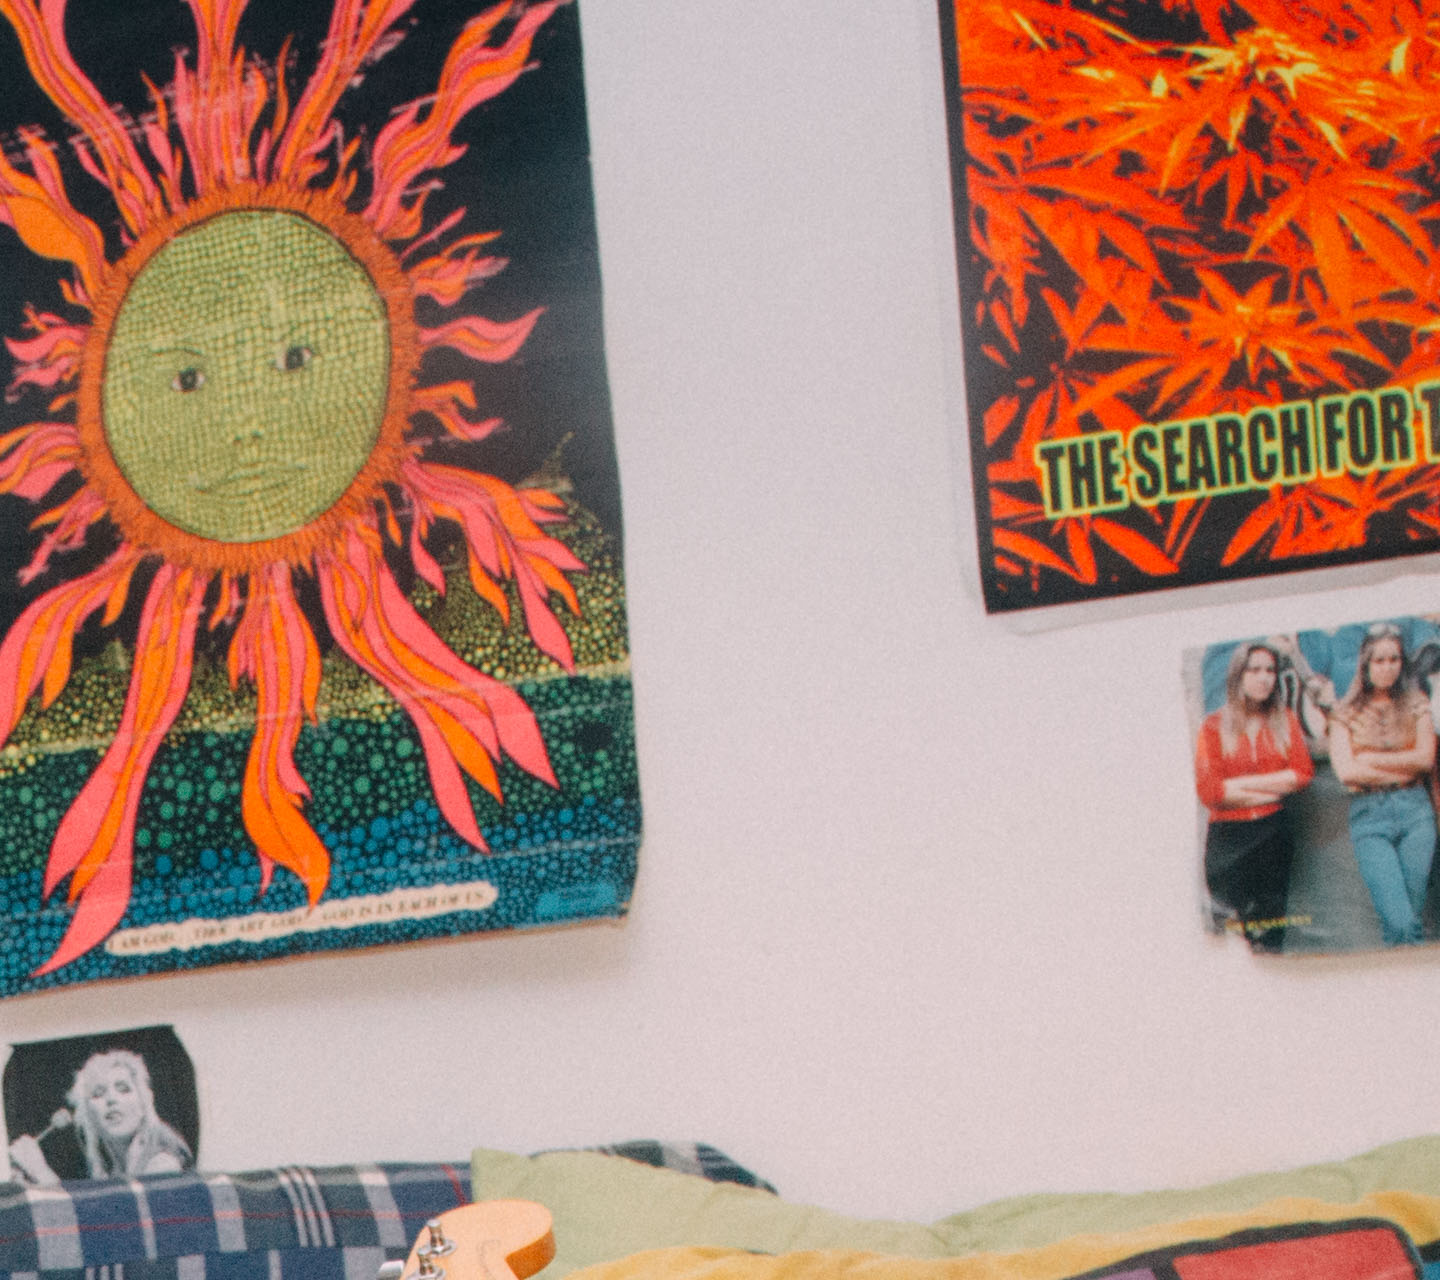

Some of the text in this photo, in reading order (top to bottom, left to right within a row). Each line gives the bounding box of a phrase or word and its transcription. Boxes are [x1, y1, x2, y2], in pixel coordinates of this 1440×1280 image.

[1037, 434, 1129, 516] THE
[1130, 404, 1315, 503] SEARCH
[1319, 389, 1414, 475] FOR
